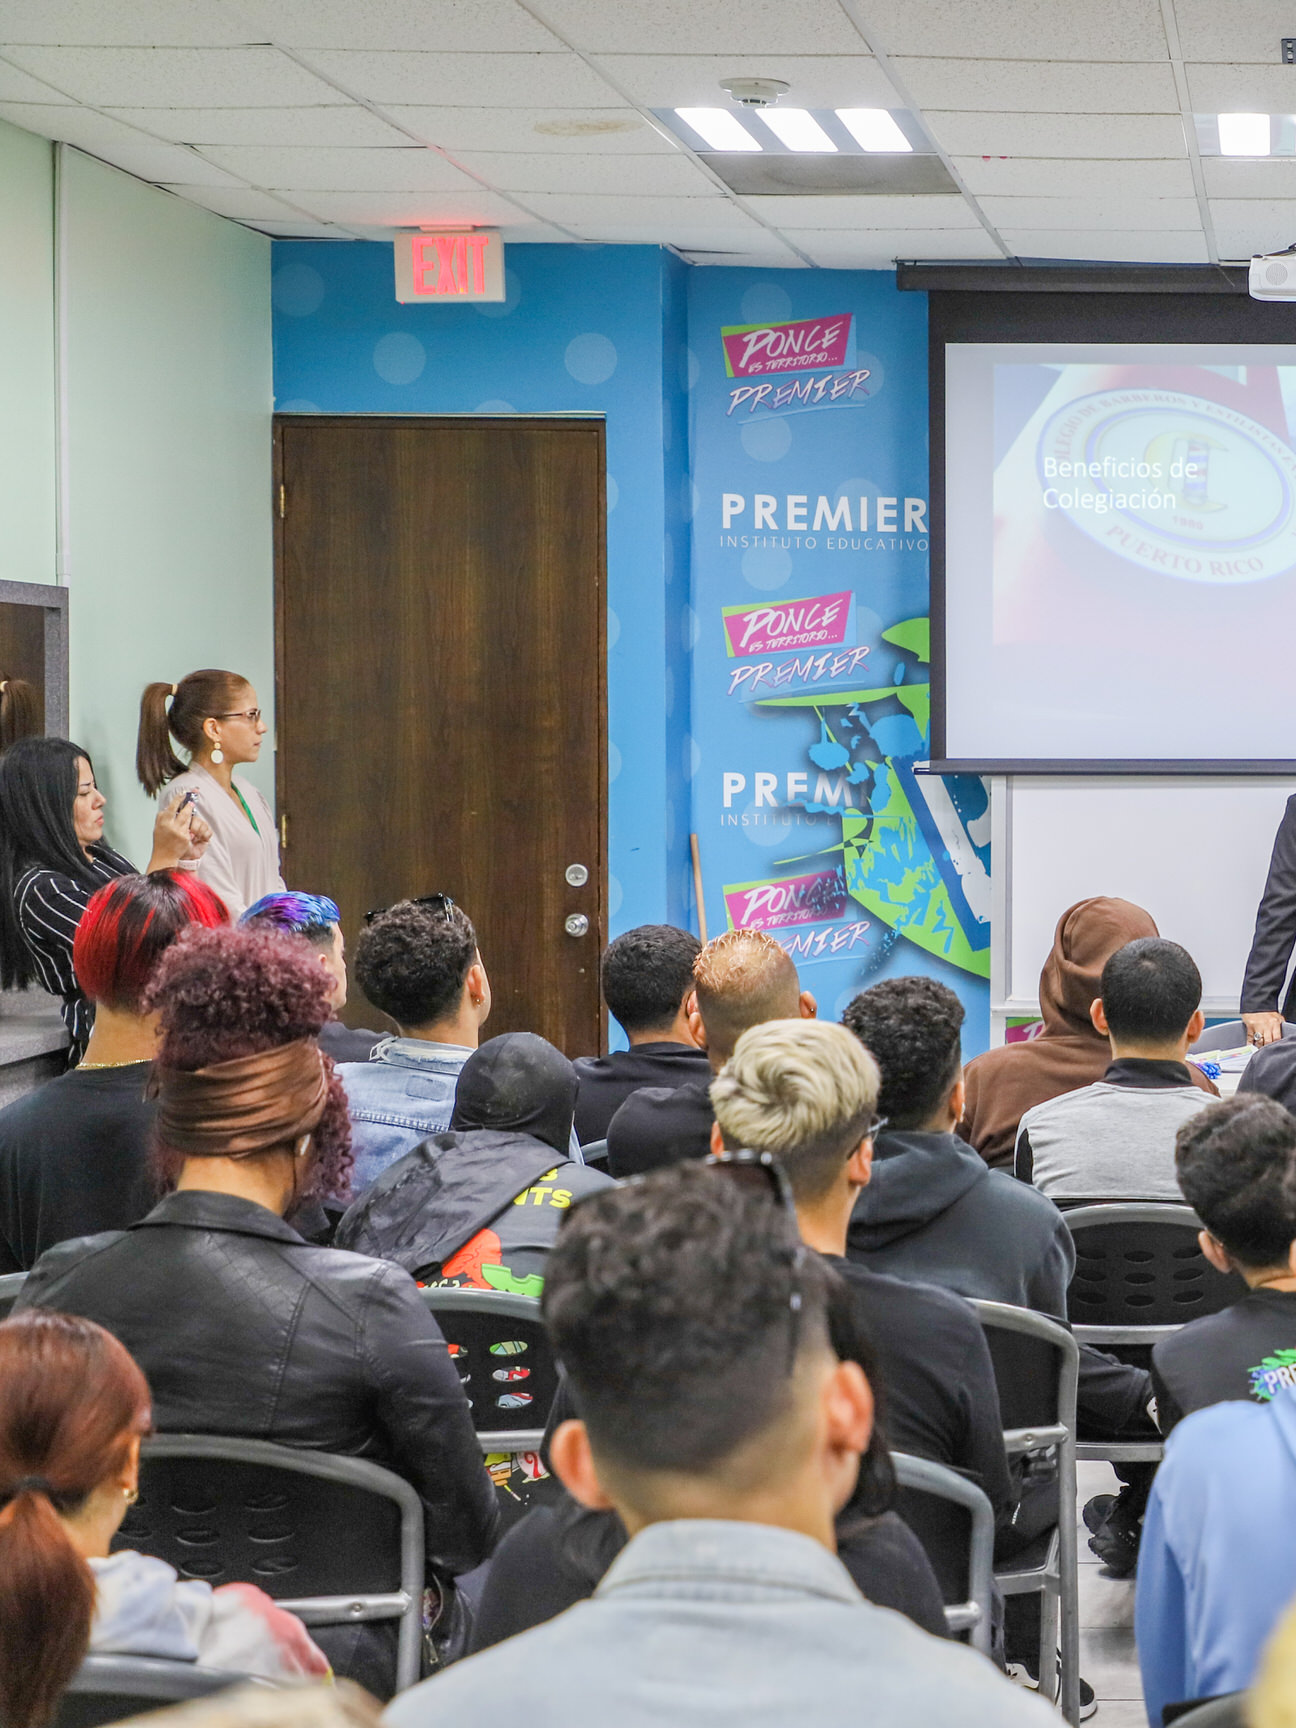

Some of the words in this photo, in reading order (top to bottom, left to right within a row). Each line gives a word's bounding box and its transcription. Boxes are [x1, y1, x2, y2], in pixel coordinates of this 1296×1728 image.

[412, 236, 488, 295] EXIT
[739, 320, 843, 368] PONCE
[749, 362, 763, 373] ES
[726, 369, 871, 416] PREMIER
[1044, 456, 1162, 479] Beneficios
[1170, 456, 1199, 479] de
[722, 493, 928, 533] PREMIER
[1043, 487, 1176, 514] Colegiación
[720, 536, 817, 550] INSTITUTO
[827, 537, 928, 552] EDUCATIVO
[1106, 525, 1203, 573] PUERTO
[1208, 556, 1264, 577] RICO
[740, 599, 843, 648] PONCE
[749, 641, 763, 652] ES
[727, 646, 870, 696] PREMIER
[723, 772, 869, 808] PREMI
[740, 877, 838, 925] PONC
[780, 920, 871, 959] EMIER
